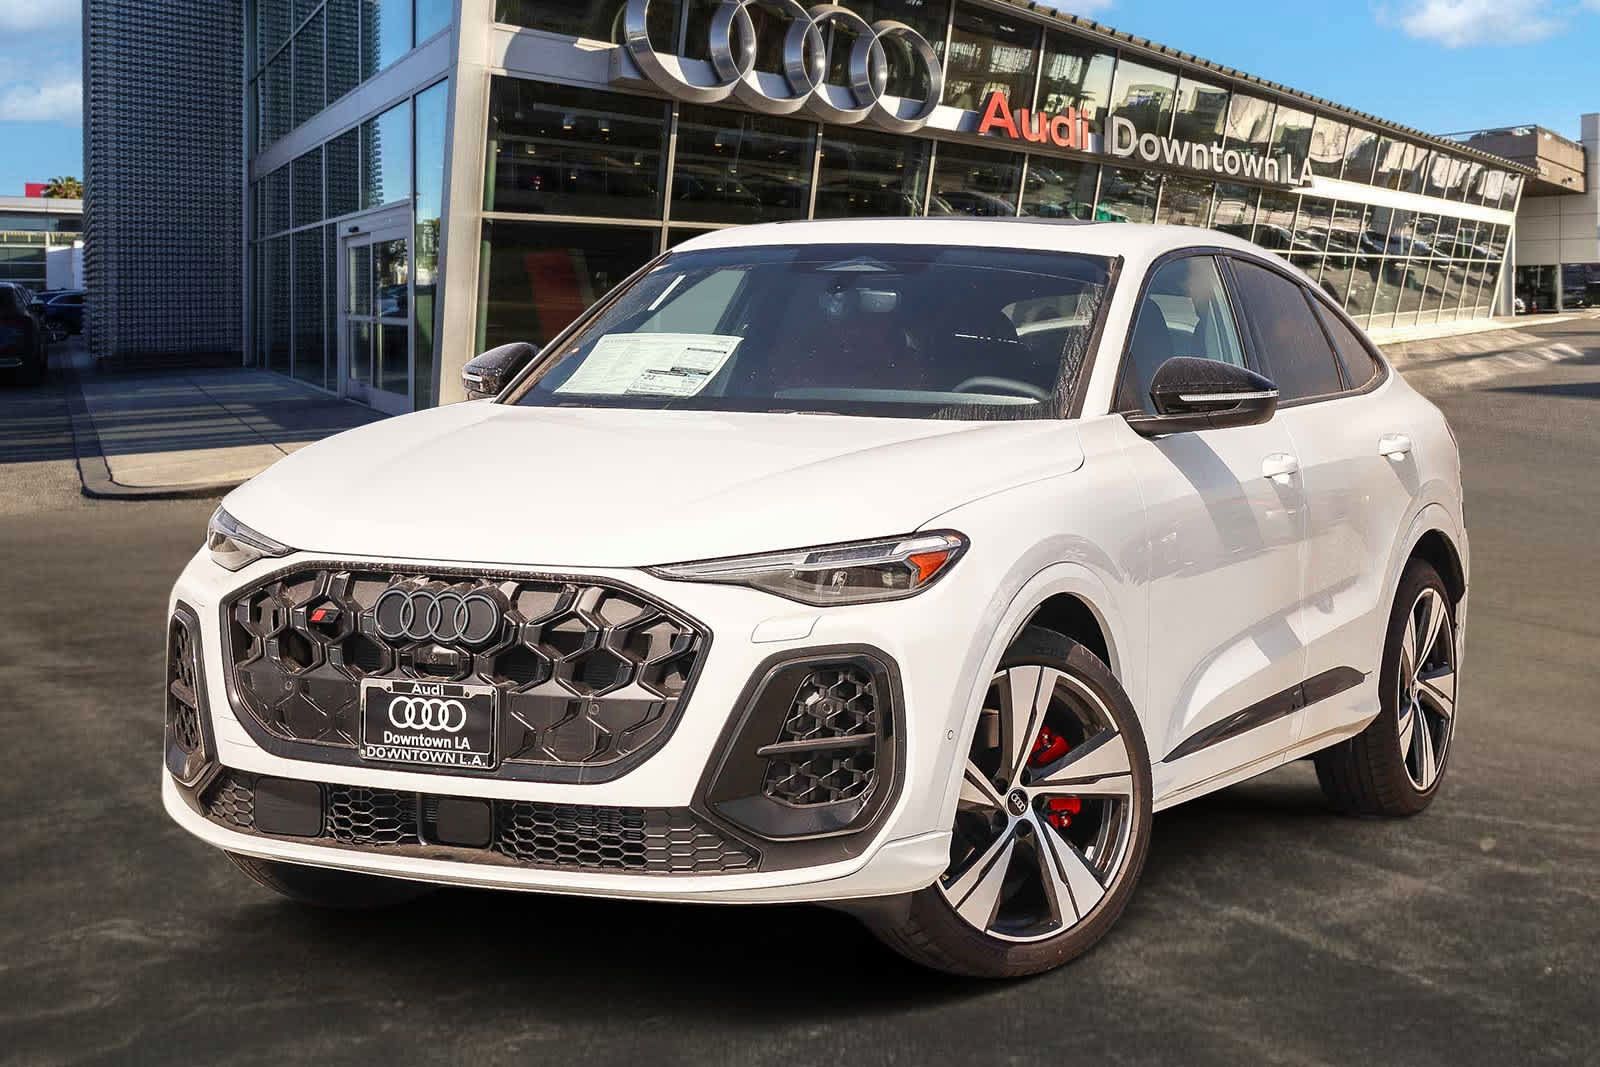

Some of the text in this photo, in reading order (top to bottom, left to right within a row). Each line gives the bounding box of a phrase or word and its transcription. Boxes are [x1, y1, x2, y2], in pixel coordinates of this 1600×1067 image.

[978, 91, 1315, 187] Audi Downtown LA
[411, 684, 445, 697] Audi
[383, 730, 471, 750] Downtown LA
[366, 746, 487, 767] DOWNTOWN L.A.
